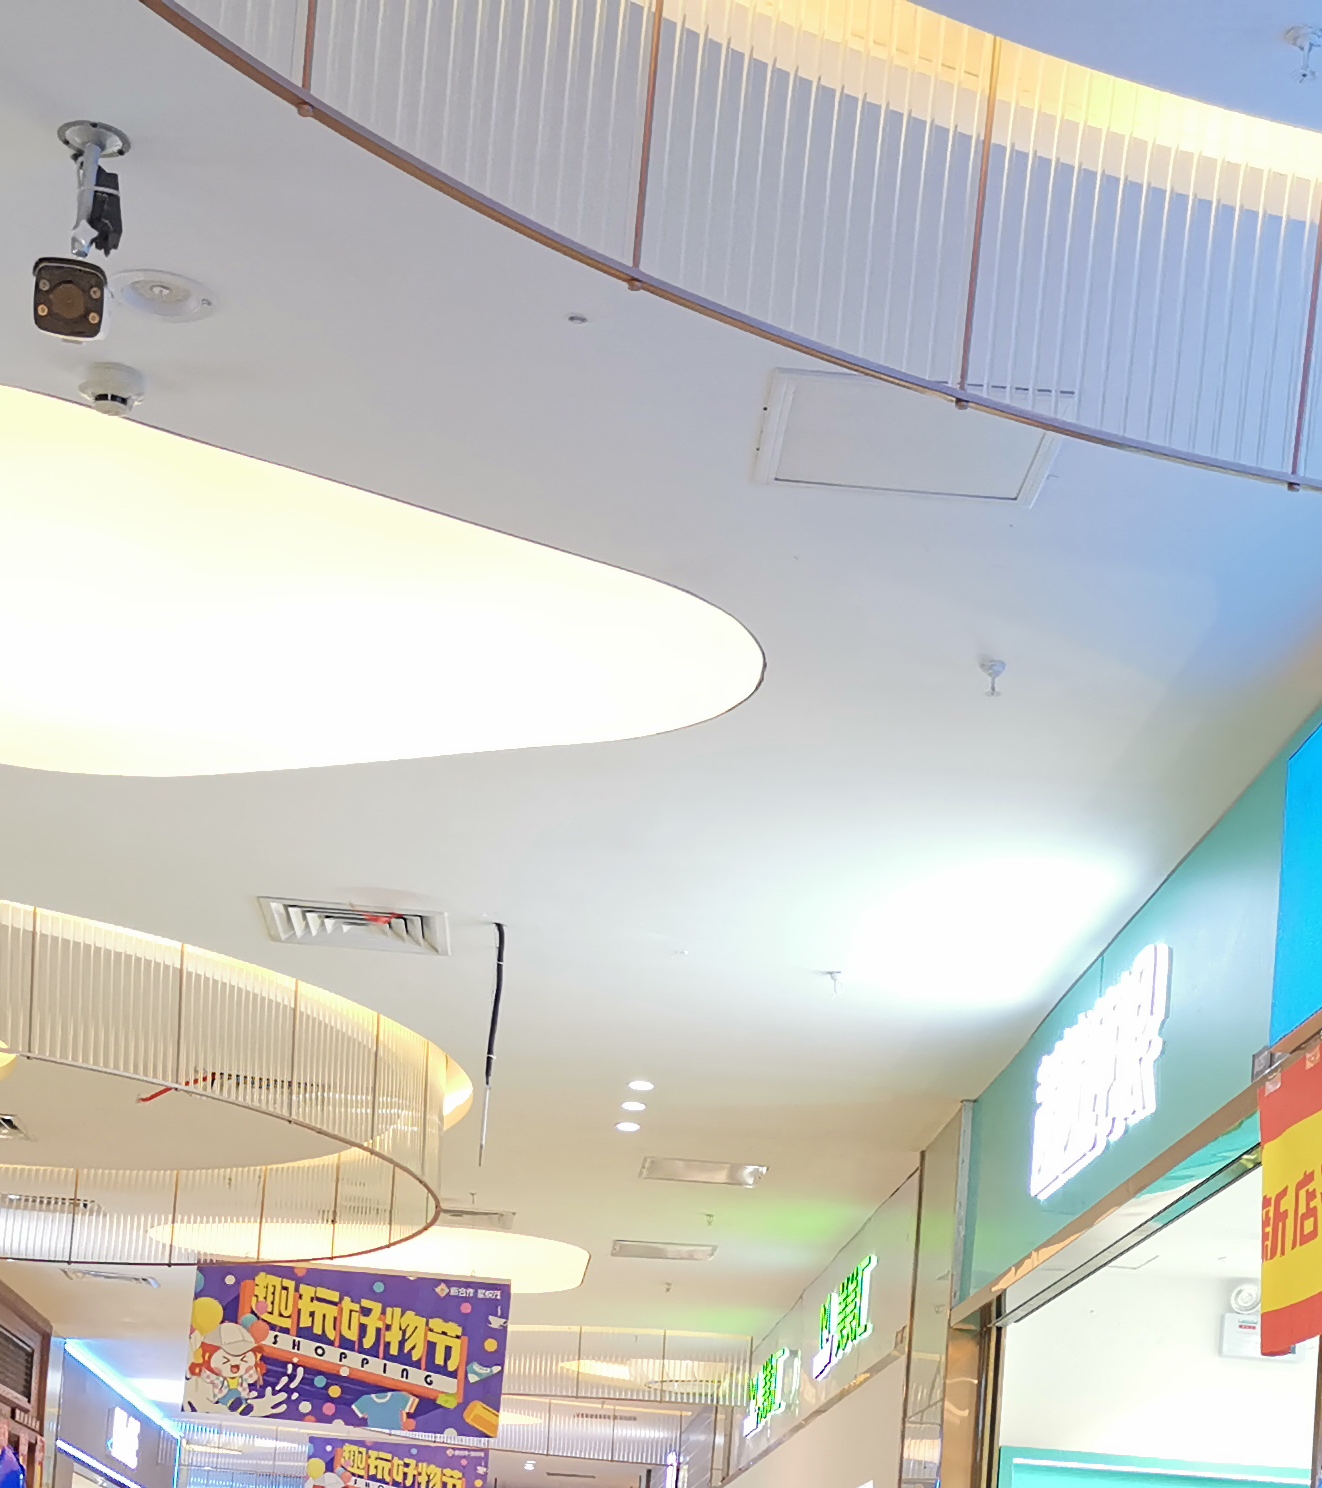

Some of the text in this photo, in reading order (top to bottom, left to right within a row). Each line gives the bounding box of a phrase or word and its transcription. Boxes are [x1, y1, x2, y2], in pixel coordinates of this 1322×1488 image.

[251, 1271, 464, 1372] 趣玩好物节
[271, 1333, 435, 1387] SHOPPING
